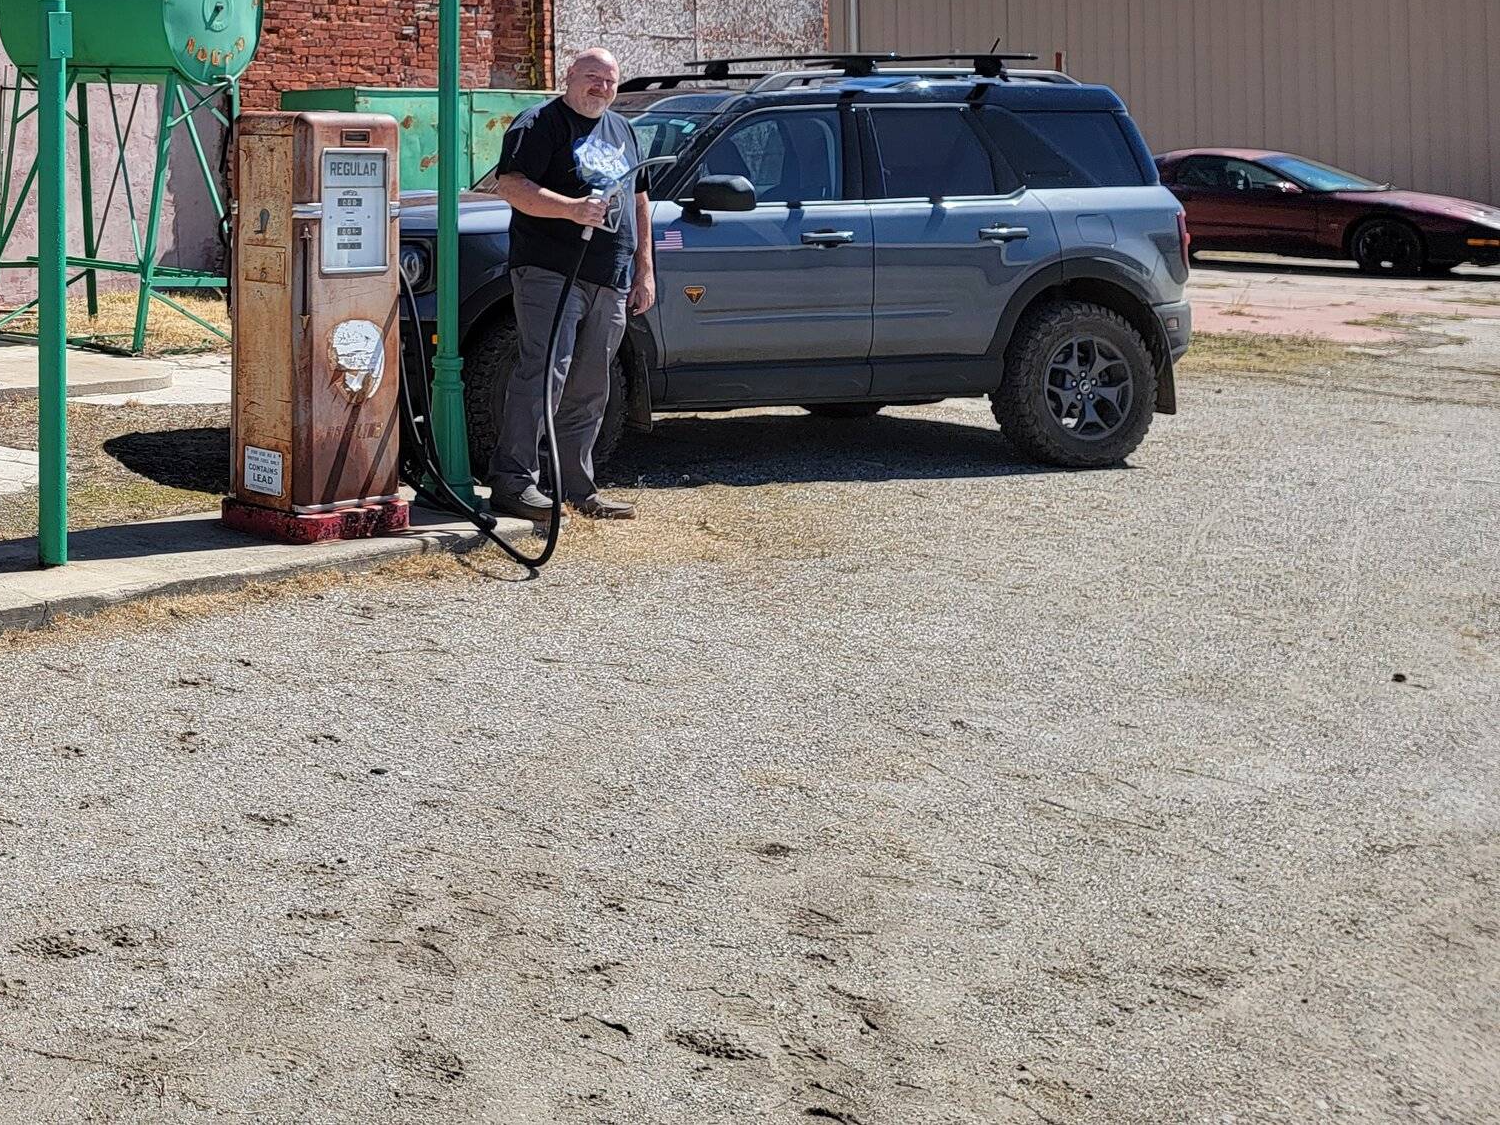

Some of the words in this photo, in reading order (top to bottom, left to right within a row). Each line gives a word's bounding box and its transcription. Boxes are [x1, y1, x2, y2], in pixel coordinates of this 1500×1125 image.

[329, 161, 377, 176] REGULAR
[248, 463, 278, 476] CONTAINS
[252, 473, 274, 485] LEAD
